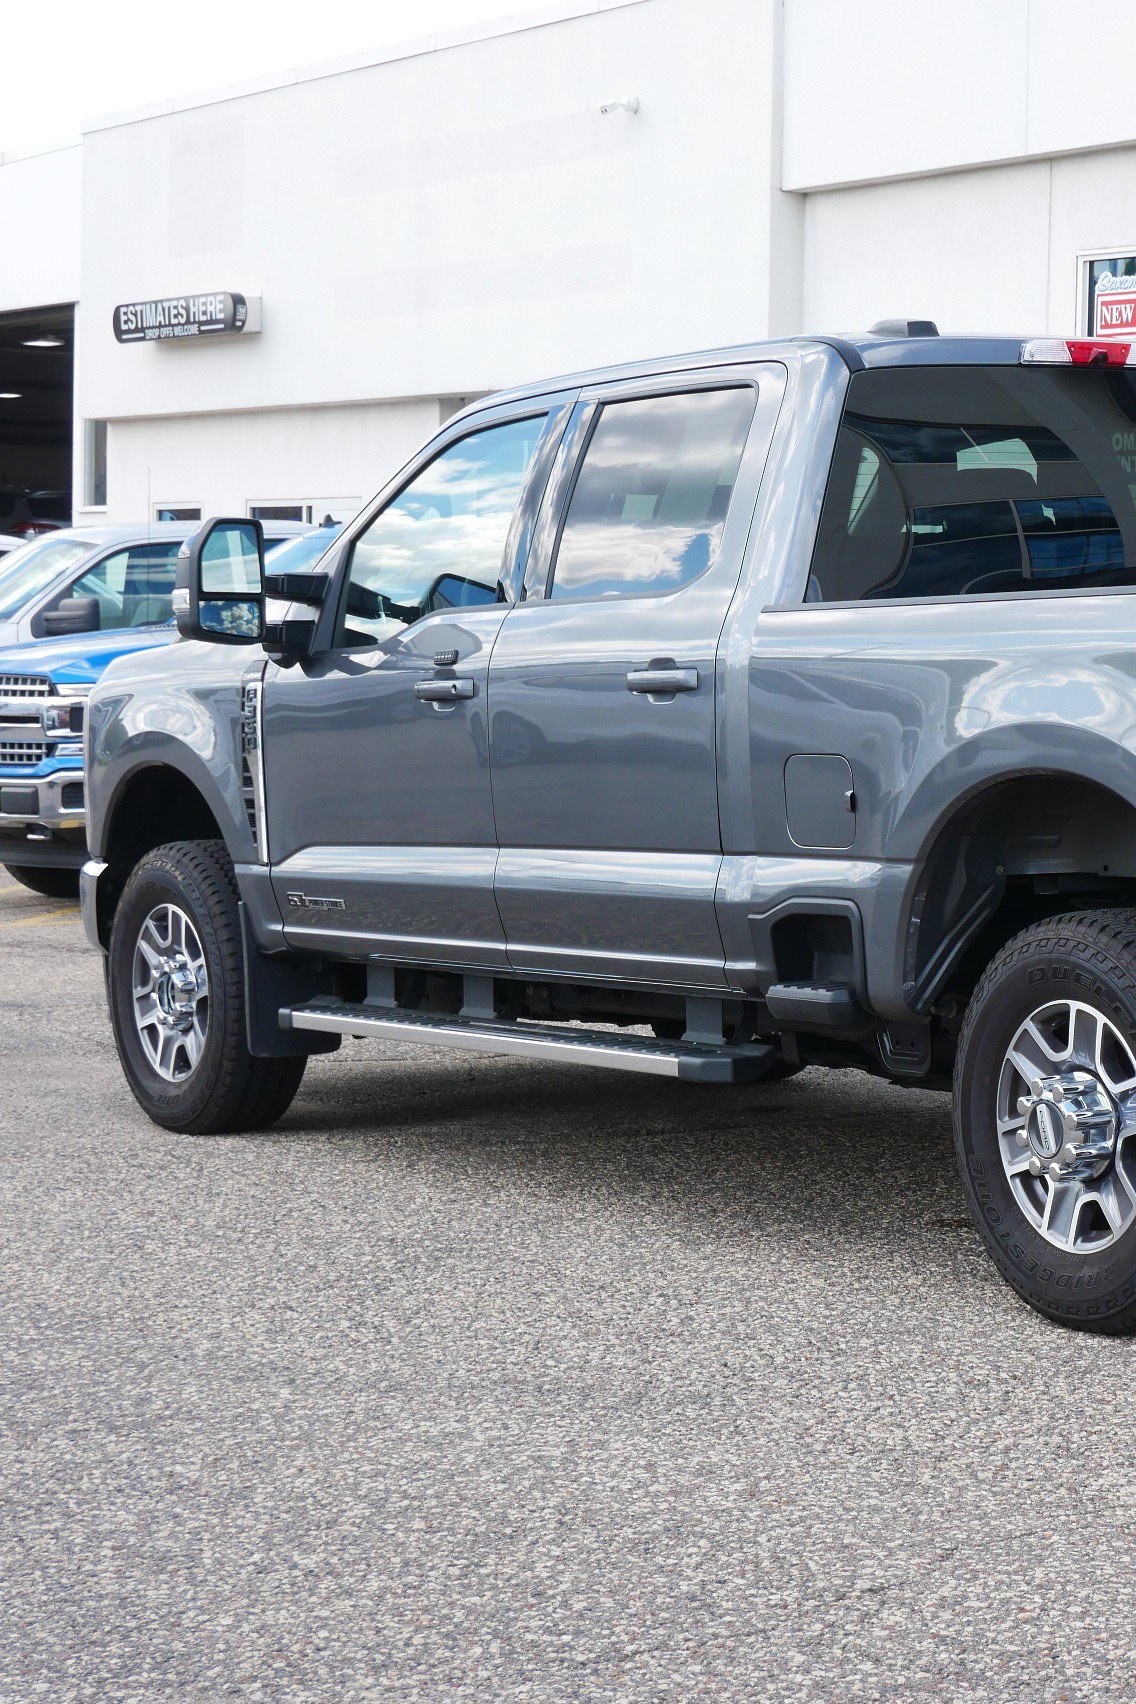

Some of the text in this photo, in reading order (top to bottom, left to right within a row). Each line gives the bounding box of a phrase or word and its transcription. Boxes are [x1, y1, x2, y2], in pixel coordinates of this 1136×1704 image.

[120, 299, 187, 331] ESTIMATES
[189, 294, 225, 322] HERE
[1101, 303, 1135, 325] NEW
[145, 324, 200, 340] DROP OFFS WELCOME
[967, 1153, 1120, 1292] BRIDGESTONE
